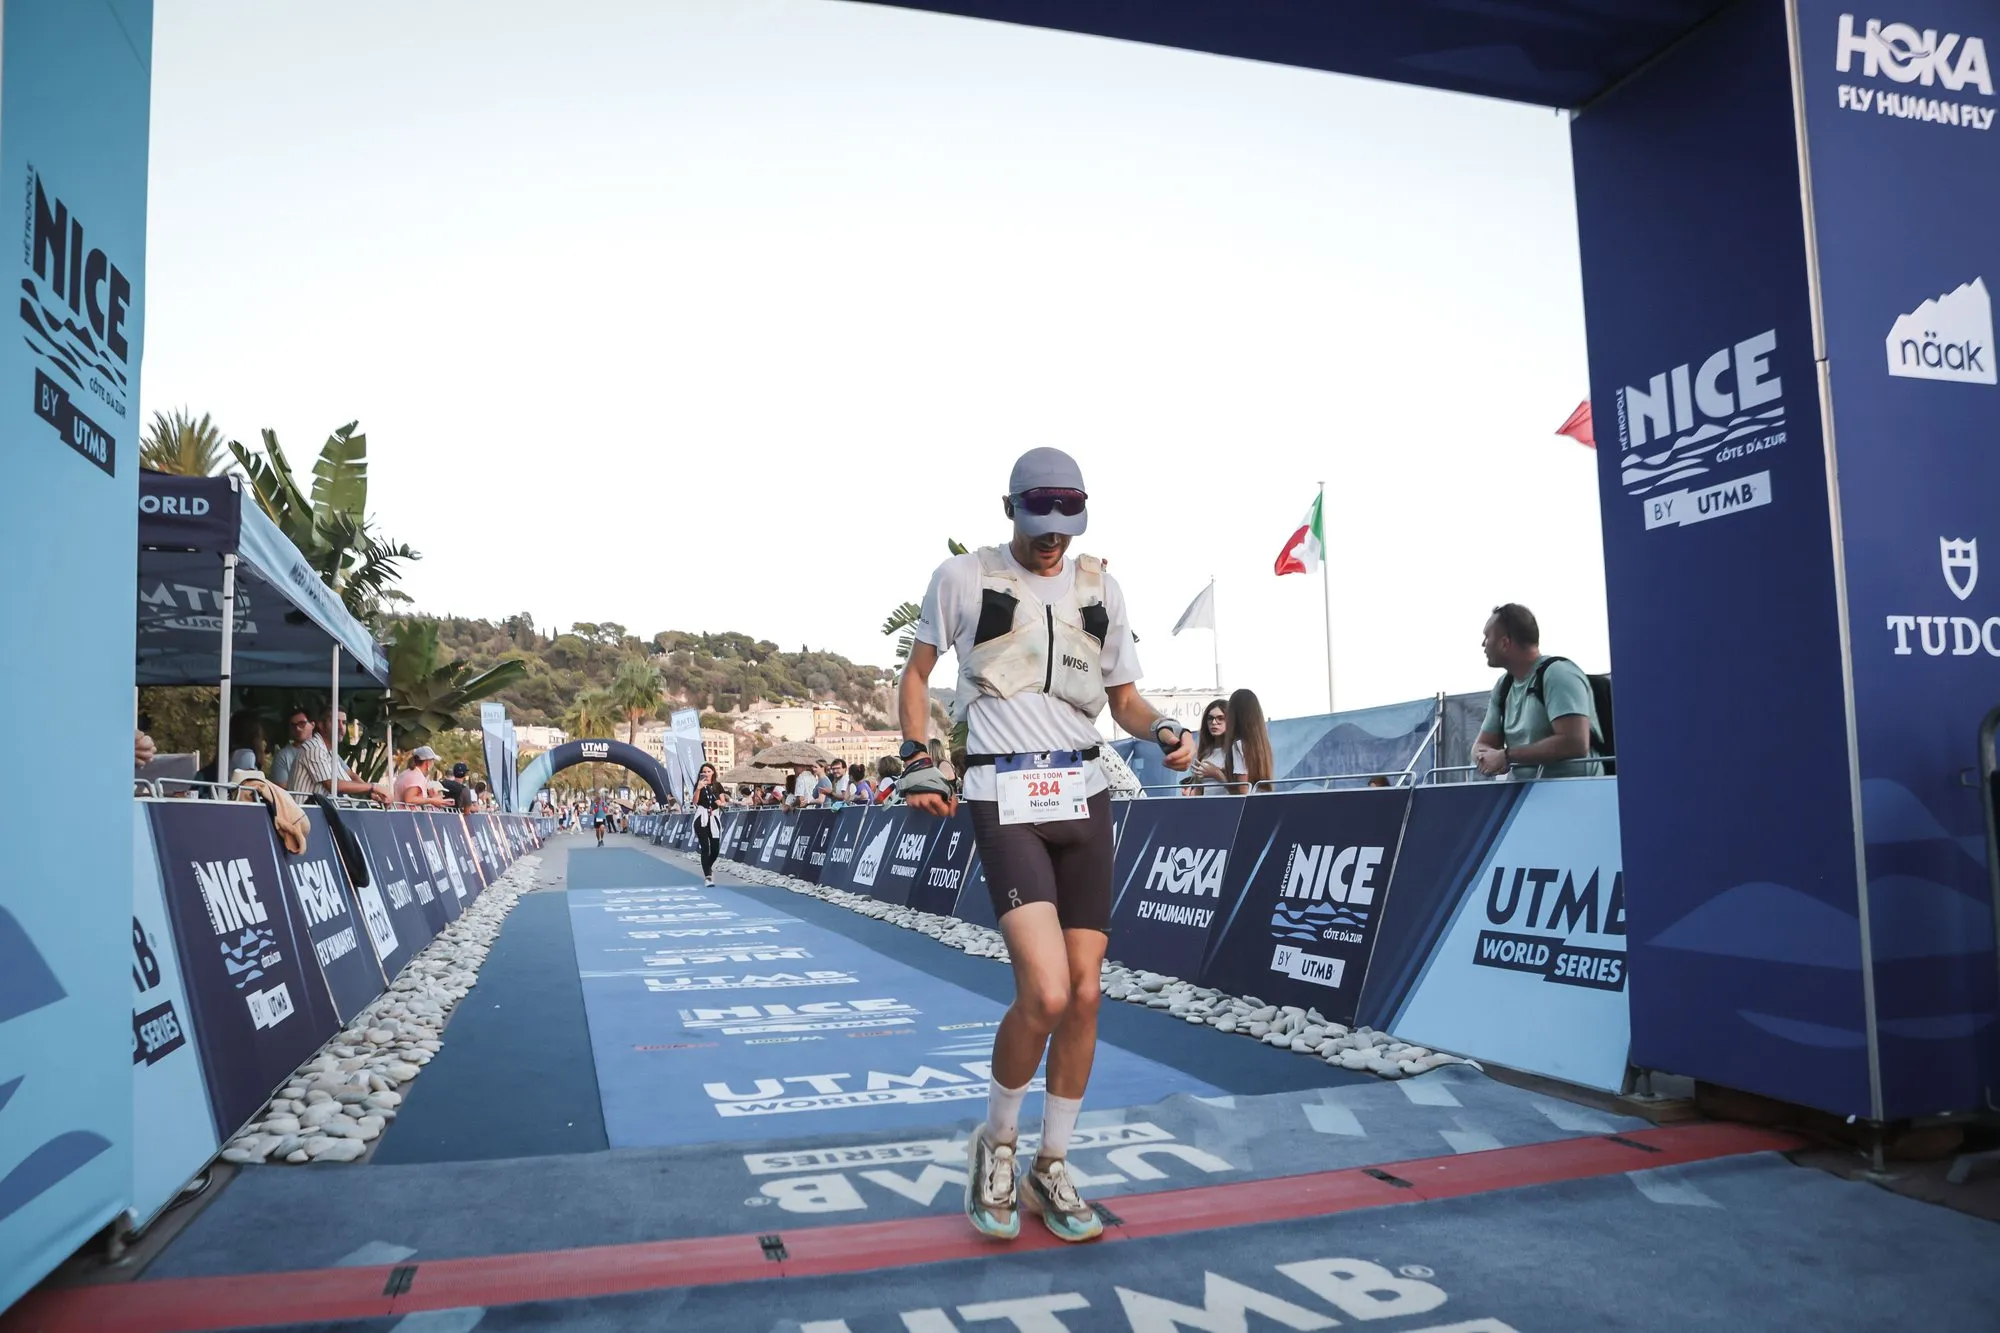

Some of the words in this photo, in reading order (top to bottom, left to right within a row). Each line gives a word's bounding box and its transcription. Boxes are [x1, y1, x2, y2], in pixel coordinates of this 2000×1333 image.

[1836, 13, 1995, 95] HOKA
[1838, 84, 1875, 112] FLY
[1876, 90, 1960, 126] HUMAN
[1961, 104, 1996, 130] FLY
[33, 170, 131, 365] NICE
[1900, 330, 1984, 372] näak
[1625, 329, 1783, 448] NICE
[42, 383, 59, 417] BY
[73, 415, 107, 464] UTMB
[1716, 448, 1744, 464] CÔTE
[139, 495, 210, 516] ORLD
[1654, 498, 1674, 521] BY
[1698, 484, 1753, 515] UTMB
[1887, 615, 2000, 656] TUDO
[581, 743, 609, 752] UTMB
[1028, 781, 1060, 797] 284
[1030, 799, 1060, 807] Nicolas
[896, 833, 927, 861] HOKA
[927, 867, 960, 889] TUDOR
[1145, 846, 1228, 898] HOKA
[1279, 843, 1297, 897] MÉTROPOLE
[1284, 843, 1385, 905] NICE
[196, 858, 269, 935] NICE
[290, 860, 347, 928] HOKA
[1137, 900, 1157, 919] FLY
[1153, 902, 1196, 926] HUMAN
[1193, 908, 1215, 929] FLY
[1323, 928, 1339, 941] CÔTE
[644, 971, 847, 985] UTMB
[1277, 951, 1292, 967] BY
[1302, 959, 1334, 980] UTMB
[1482, 938, 1550, 966] WORLD
[1554, 953, 1622, 983] SERIES
[692, 998, 911, 1021] NICE
[139, 1010, 181, 1053] SERIES
[735, 1093, 898, 1113] WORLD
[918, 1078, 1047, 1101] SERS
[762, 1145, 932, 1169] SERIES
